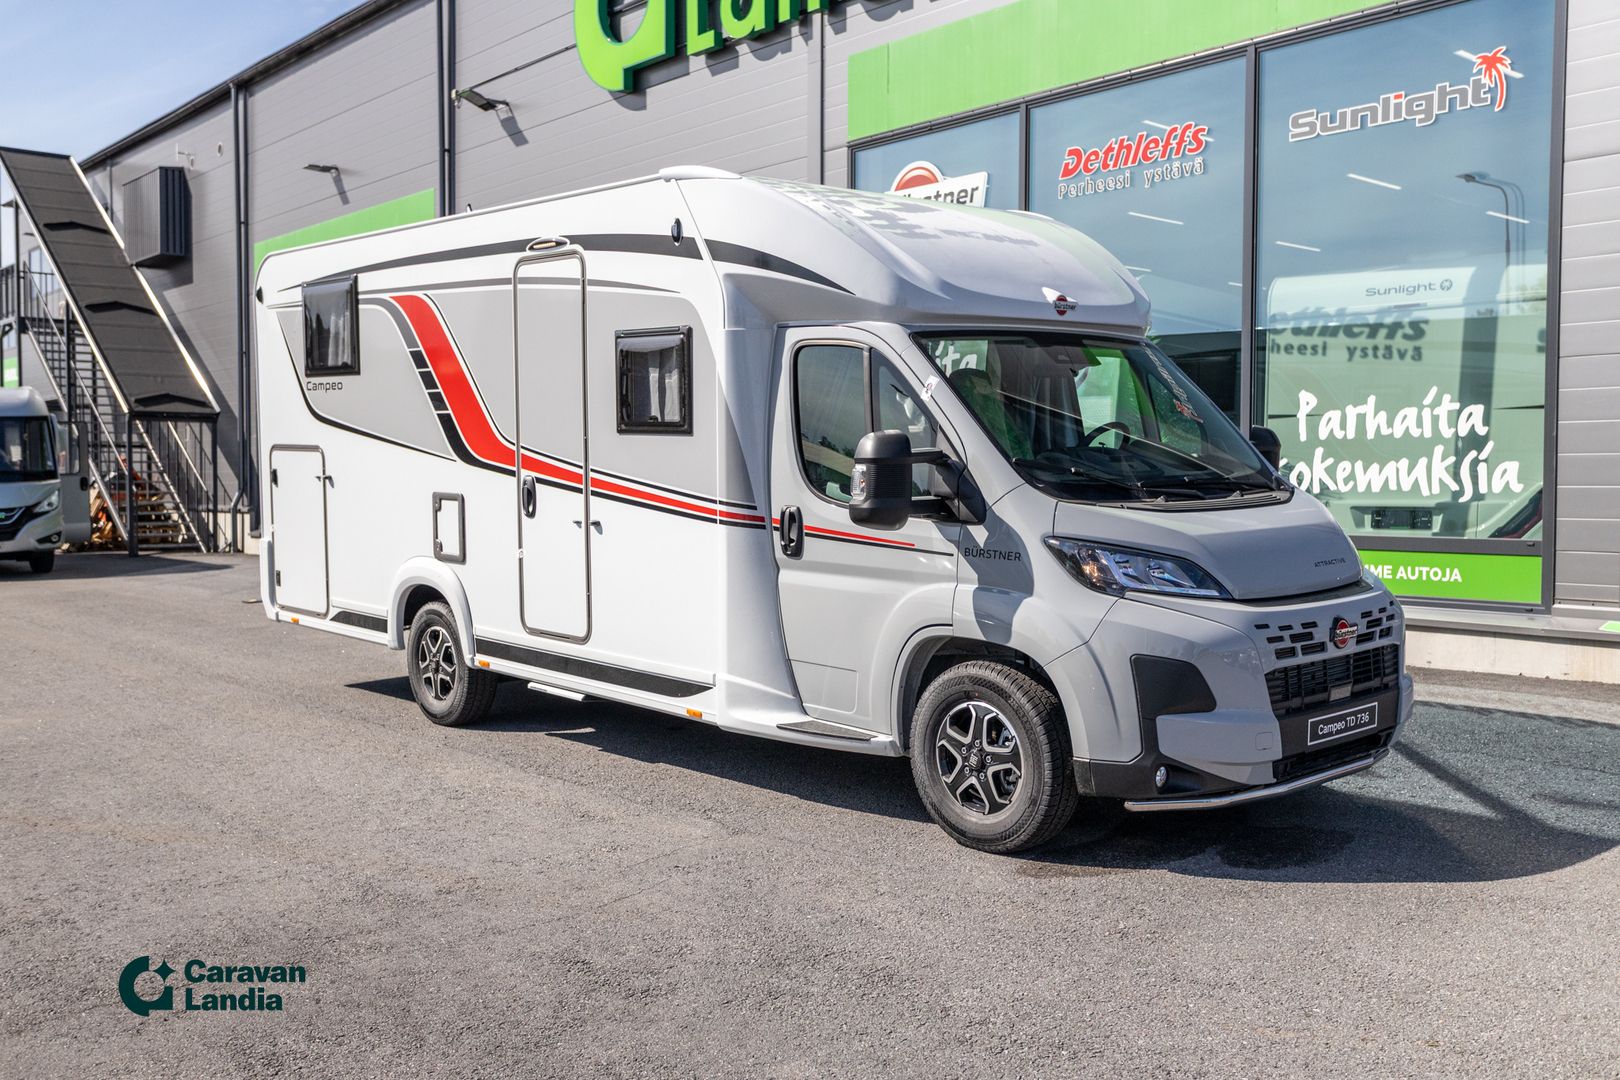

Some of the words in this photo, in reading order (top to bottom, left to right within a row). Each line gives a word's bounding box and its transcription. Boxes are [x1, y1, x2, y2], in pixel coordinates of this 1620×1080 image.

[1289, 76, 1490, 141] Sunlight
[1059, 122, 1208, 180] Dethleffs
[1058, 170, 1131, 199] Perheesi
[1144, 157, 1205, 188] ystävä
[1365, 282, 1436, 297] Sunlight
[306, 381, 343, 393] Campeo
[964, 546, 1021, 561] BÜRSTNER
[1396, 565, 1463, 583] AUTOJA
[1318, 720, 1345, 735] Campeo
[1346, 716, 1355, 727] TD
[1357, 712, 1369, 724] 736
